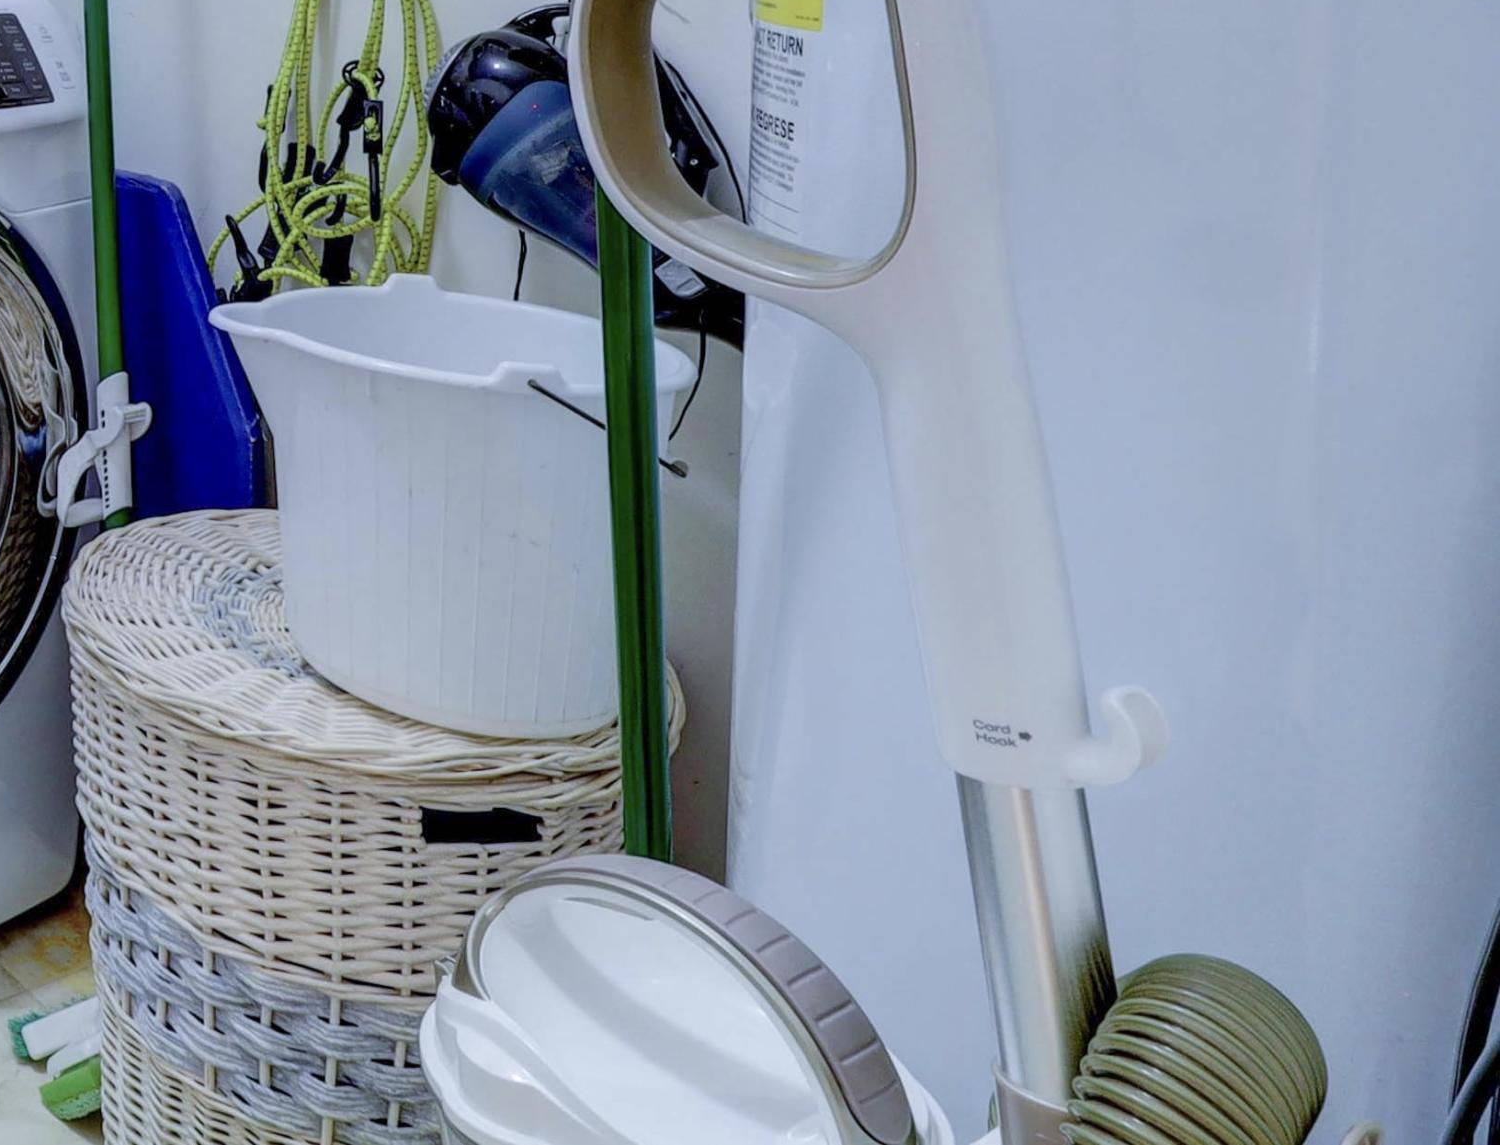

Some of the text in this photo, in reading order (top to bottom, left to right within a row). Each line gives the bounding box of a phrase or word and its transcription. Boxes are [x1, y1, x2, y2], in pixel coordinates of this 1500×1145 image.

[767, 29, 803, 56] RETURN
[972, 719, 1011, 735] Cord
[974, 730, 1019, 749] Hook
